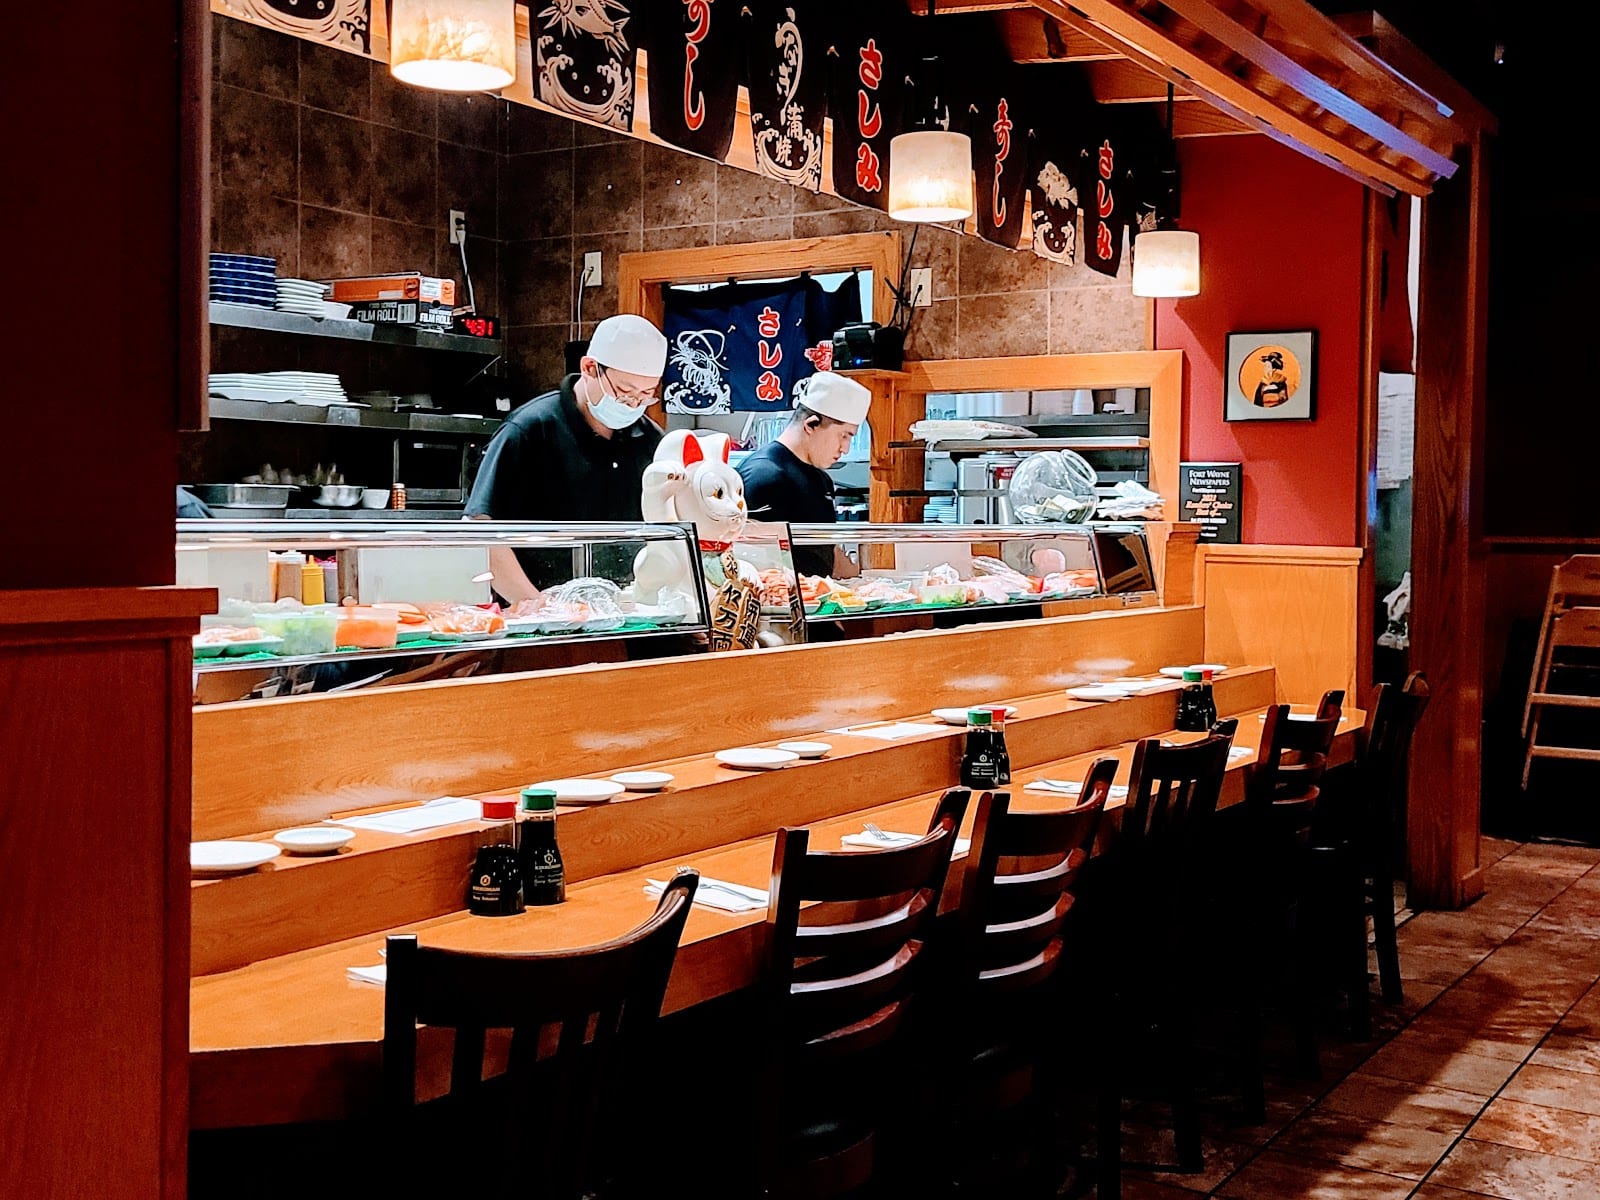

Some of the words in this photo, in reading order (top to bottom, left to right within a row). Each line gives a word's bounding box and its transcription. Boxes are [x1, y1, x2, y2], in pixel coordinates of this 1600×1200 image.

[856, 38, 883, 193] さしみ
[993, 98, 1013, 228] すし
[1097, 139, 1114, 260] さしみ
[357, 310, 376, 322] FILM
[377, 308, 397, 321] ROLL
[420, 313, 435, 323] FILM
[435, 314, 451, 325] ROLL
[756, 306, 783, 401] さしみ
[1189, 478, 1230, 486] NEWSPAPERS
